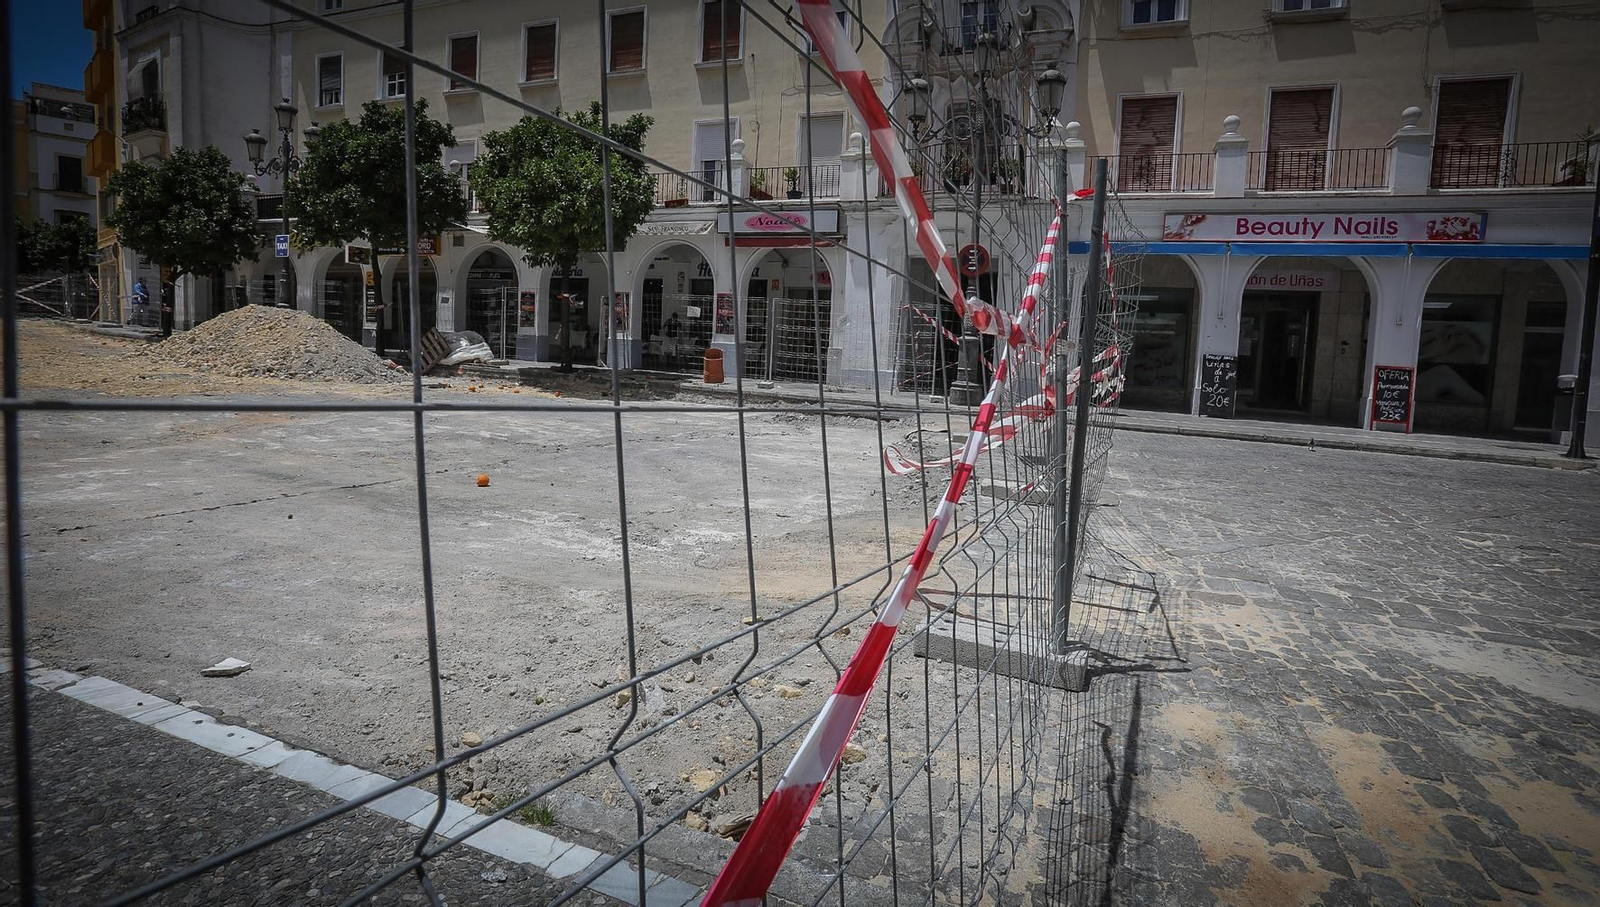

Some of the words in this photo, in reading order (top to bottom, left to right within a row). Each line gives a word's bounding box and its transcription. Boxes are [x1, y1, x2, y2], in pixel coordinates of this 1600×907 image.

[1236, 217, 1325, 239] Beauty
[1334, 216, 1399, 235] Nails
[277, 242, 288, 250] TAXI
[1270, 274, 1286, 286] de
[1290, 274, 1324, 287] Uñas
[1379, 370, 1409, 381] OFERTA
[1207, 393, 1230, 407] 20€
